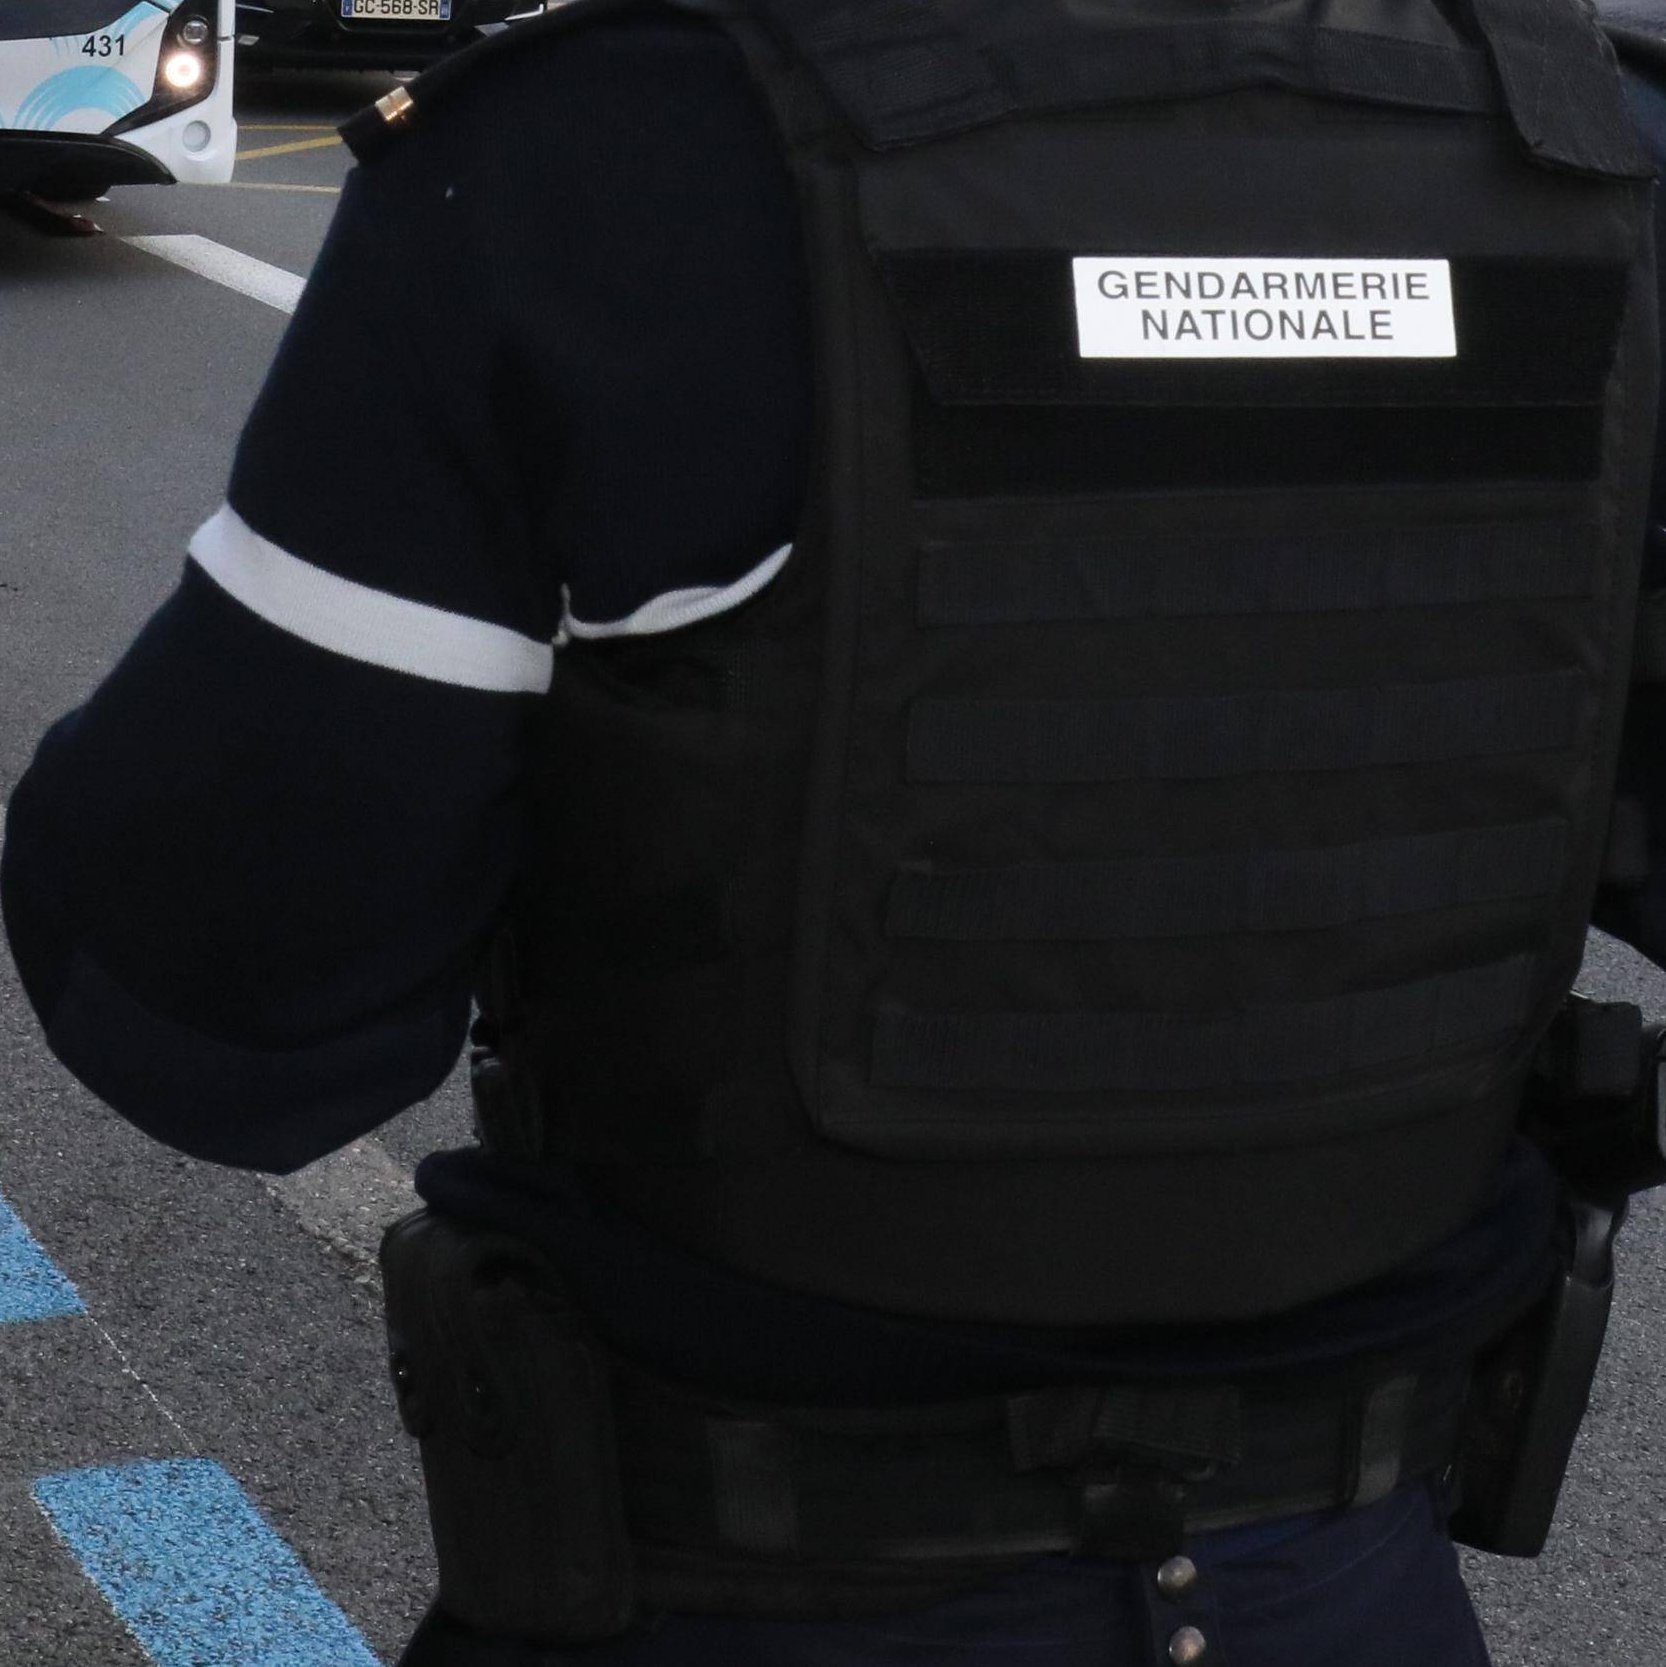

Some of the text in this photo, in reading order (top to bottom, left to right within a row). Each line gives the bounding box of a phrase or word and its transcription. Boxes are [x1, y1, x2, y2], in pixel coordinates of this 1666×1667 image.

[81, 34, 126, 57] 431
[1097, 270, 1430, 300] GENDARMERIE
[1141, 308, 1394, 341] NATIONALE
